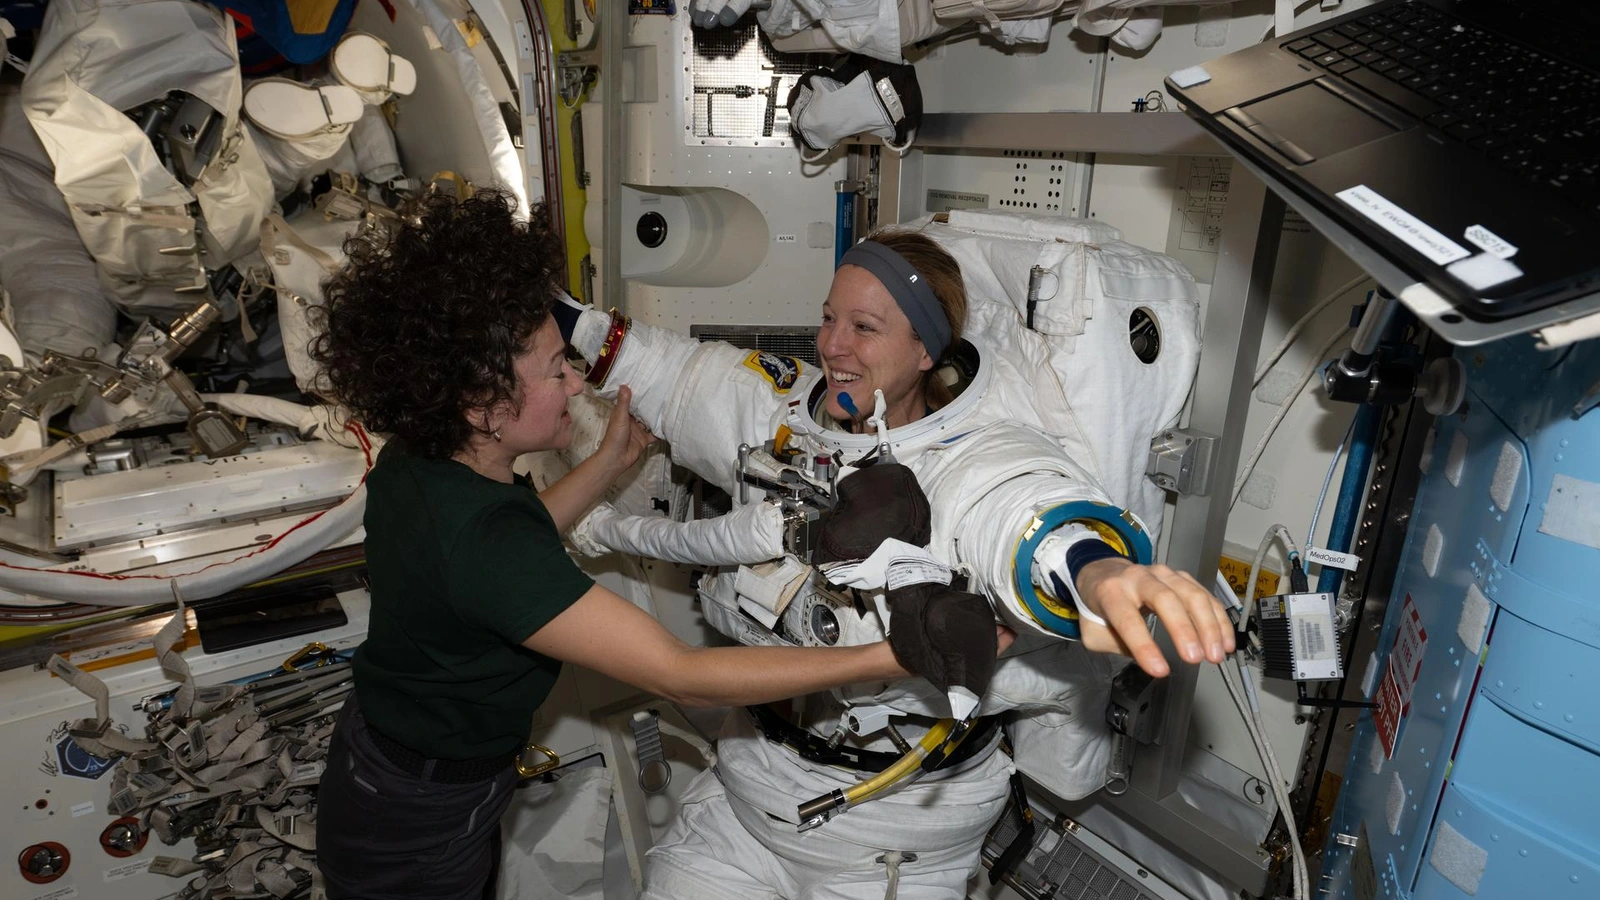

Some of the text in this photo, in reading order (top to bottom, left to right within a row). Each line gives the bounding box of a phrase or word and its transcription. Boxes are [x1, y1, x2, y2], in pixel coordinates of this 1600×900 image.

[958, 194, 985, 203] RECEPTACLE
[1310, 550, 1346, 564] MedOps02
[1402, 638, 1412, 668] FIRE
[1383, 713, 1394, 748] PFE
